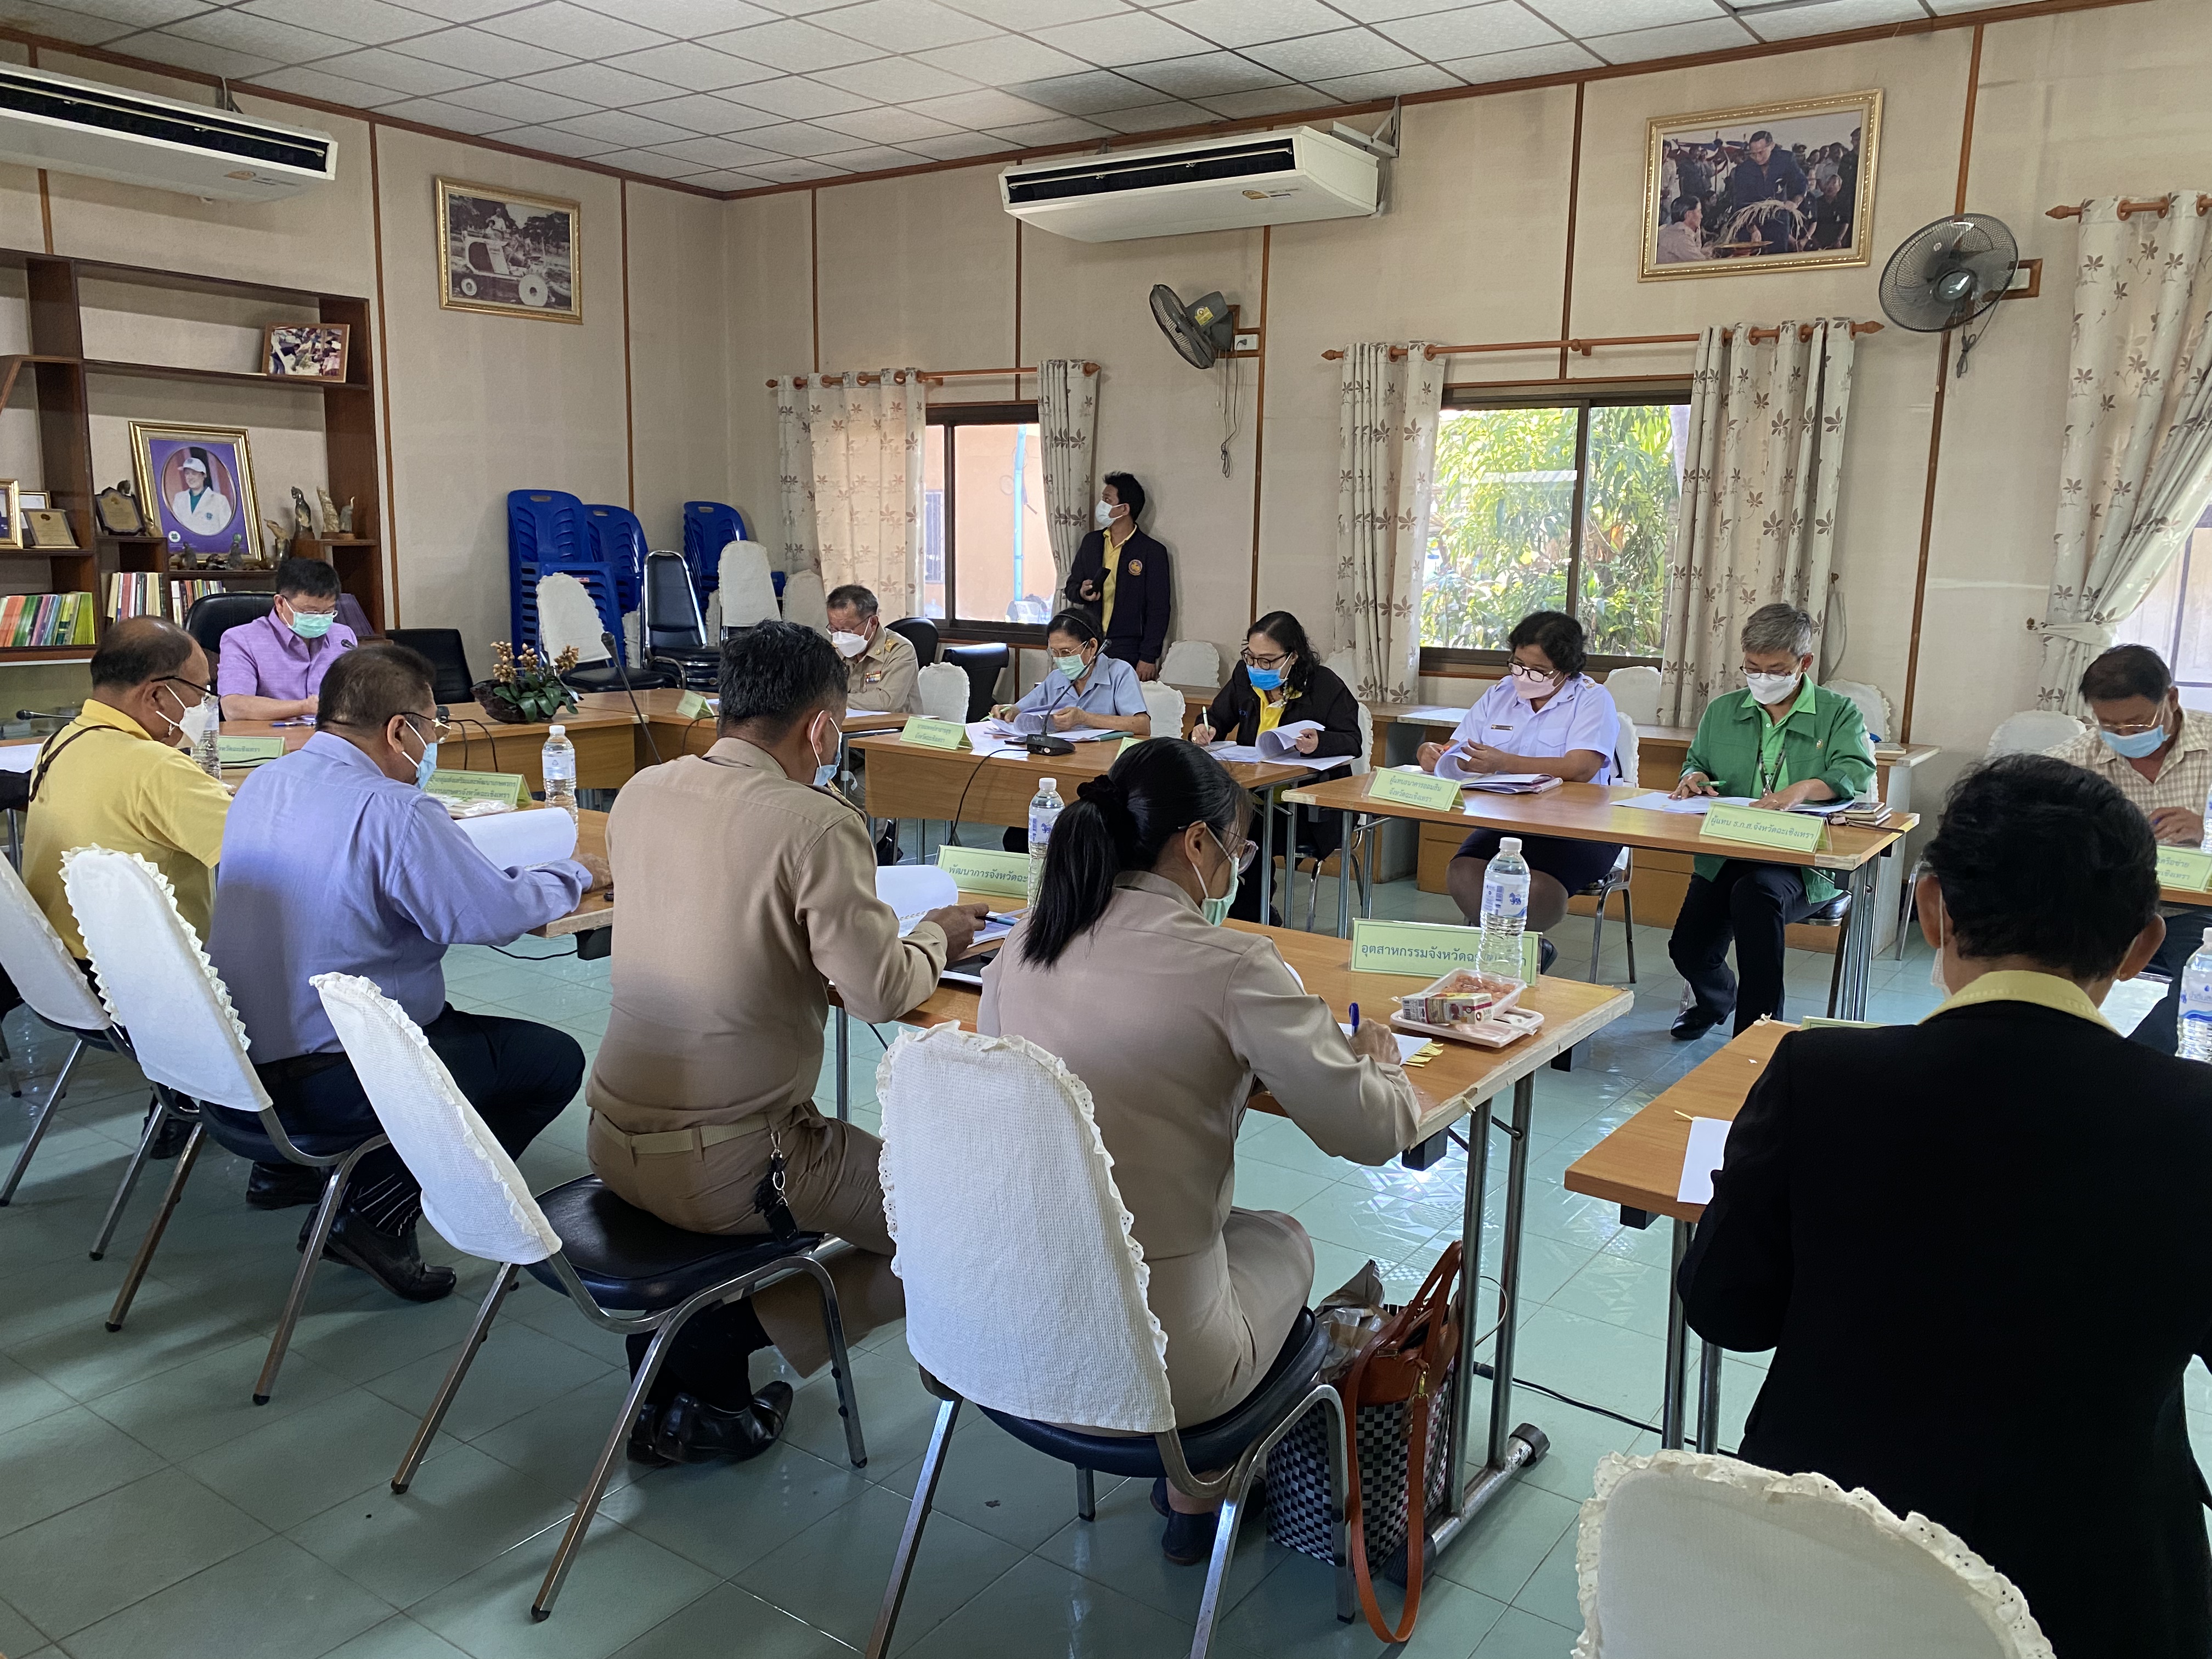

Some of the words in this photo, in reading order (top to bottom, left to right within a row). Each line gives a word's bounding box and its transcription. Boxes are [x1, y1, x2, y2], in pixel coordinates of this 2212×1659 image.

[1711, 815, 1731, 826] ผู้แทน
[949, 864, 1028, 882] พัฒนาการจังหวัดฉะ
